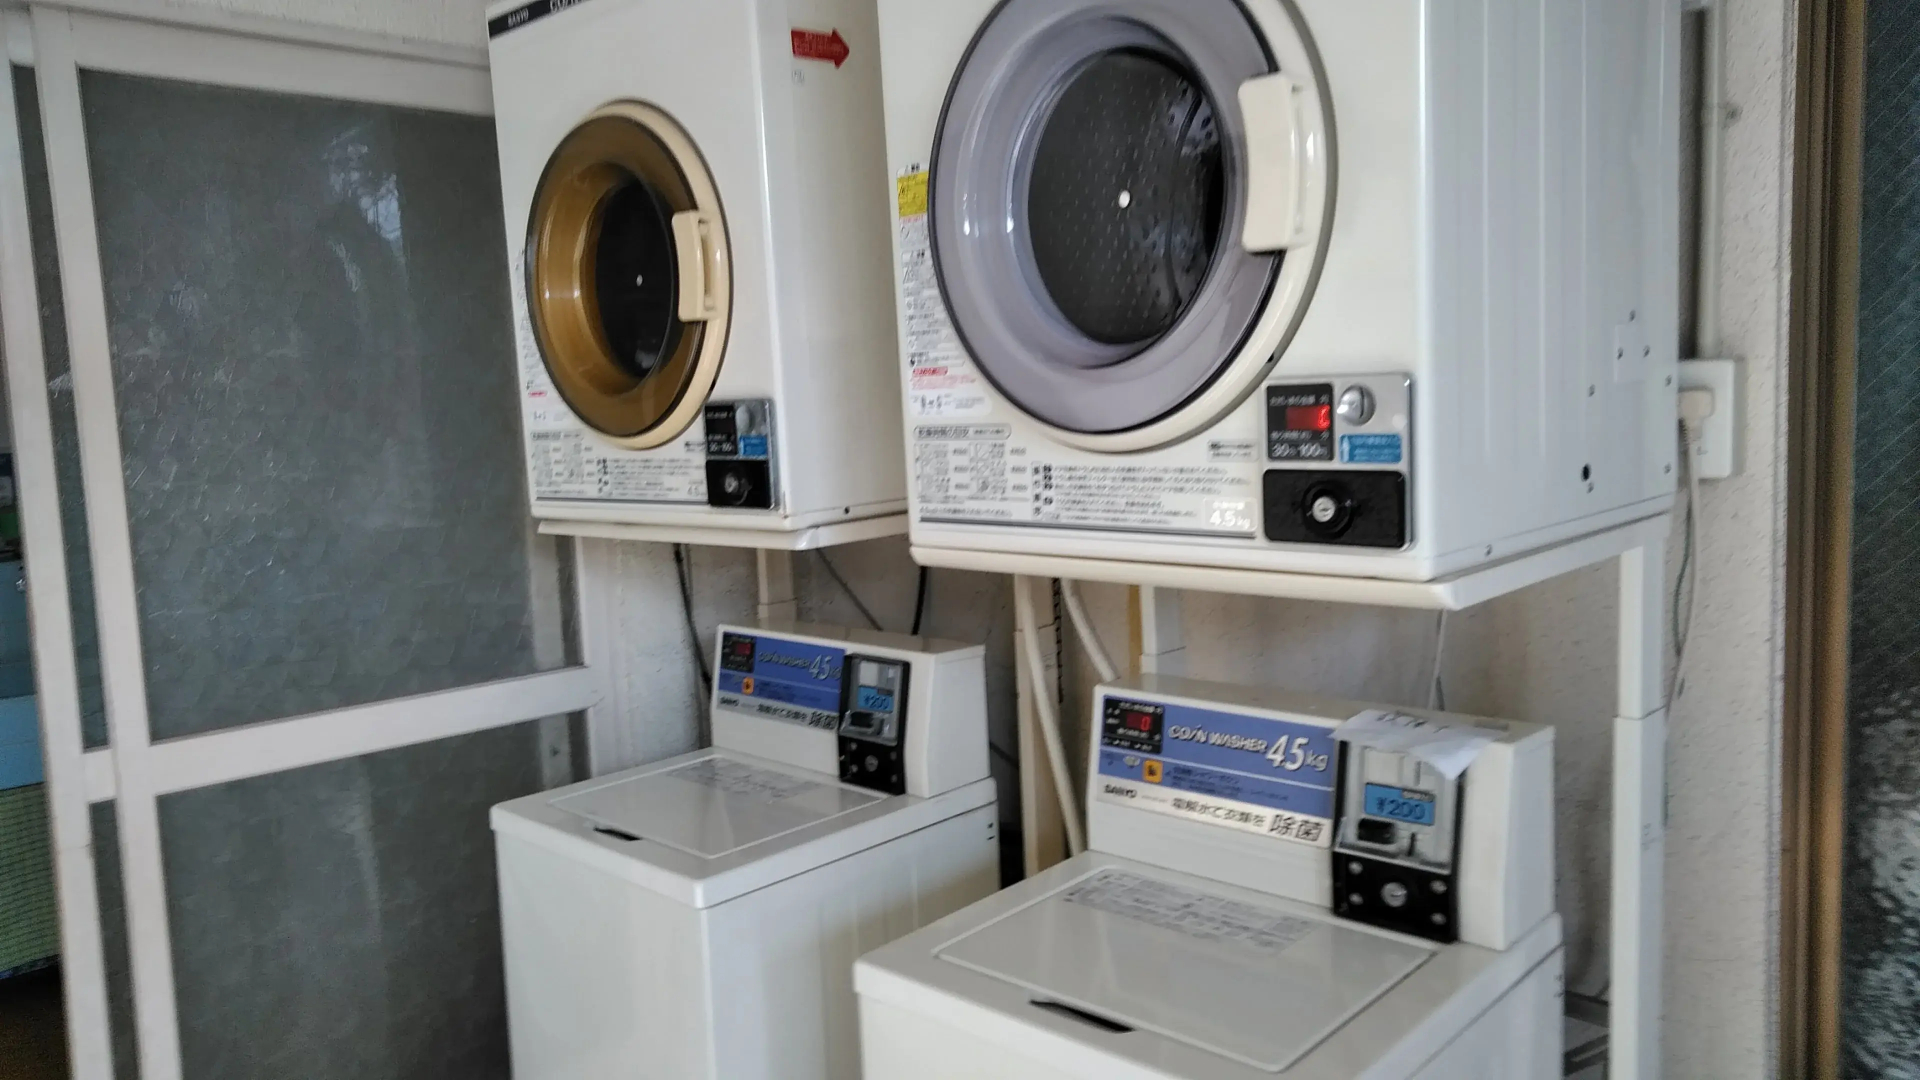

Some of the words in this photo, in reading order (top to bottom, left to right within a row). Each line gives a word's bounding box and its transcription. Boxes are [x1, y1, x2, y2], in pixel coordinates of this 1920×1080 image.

[1168, 723, 1207, 744] COIN
[1208, 731, 1268, 754] WASHER
[1103, 784, 1138, 799] SANYO
[1268, 813, 1325, 843] 除菌
[1376, 796, 1427, 821] ¥200
